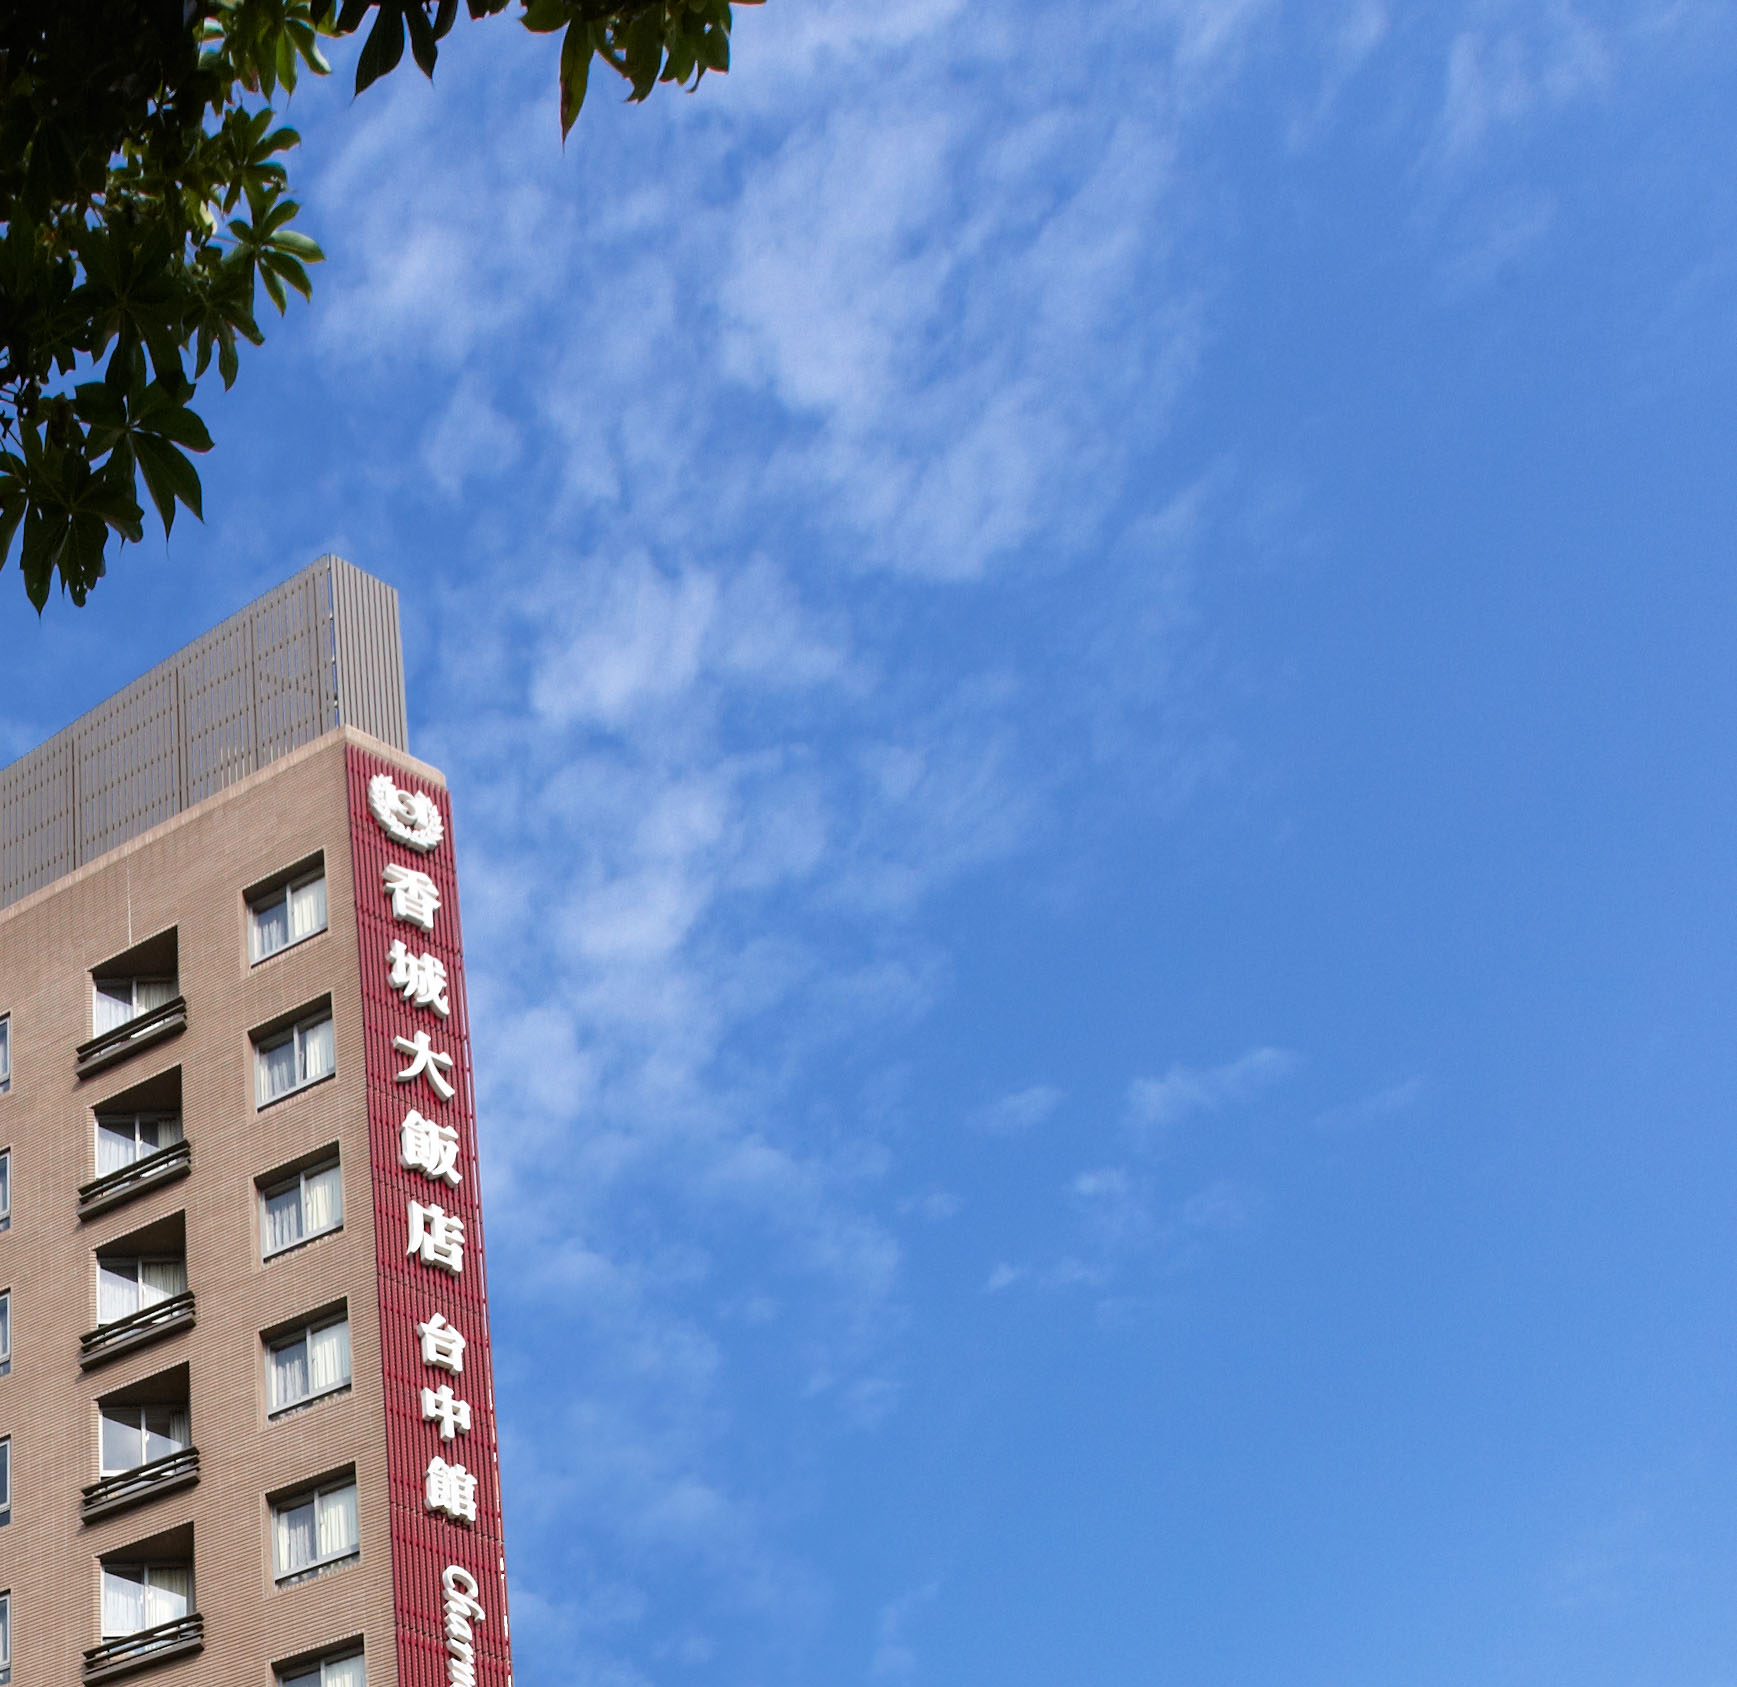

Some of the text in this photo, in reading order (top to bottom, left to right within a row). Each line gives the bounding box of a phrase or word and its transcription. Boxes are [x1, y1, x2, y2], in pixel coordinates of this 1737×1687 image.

[382, 862, 478, 1525] 香城大飯店 台中館
